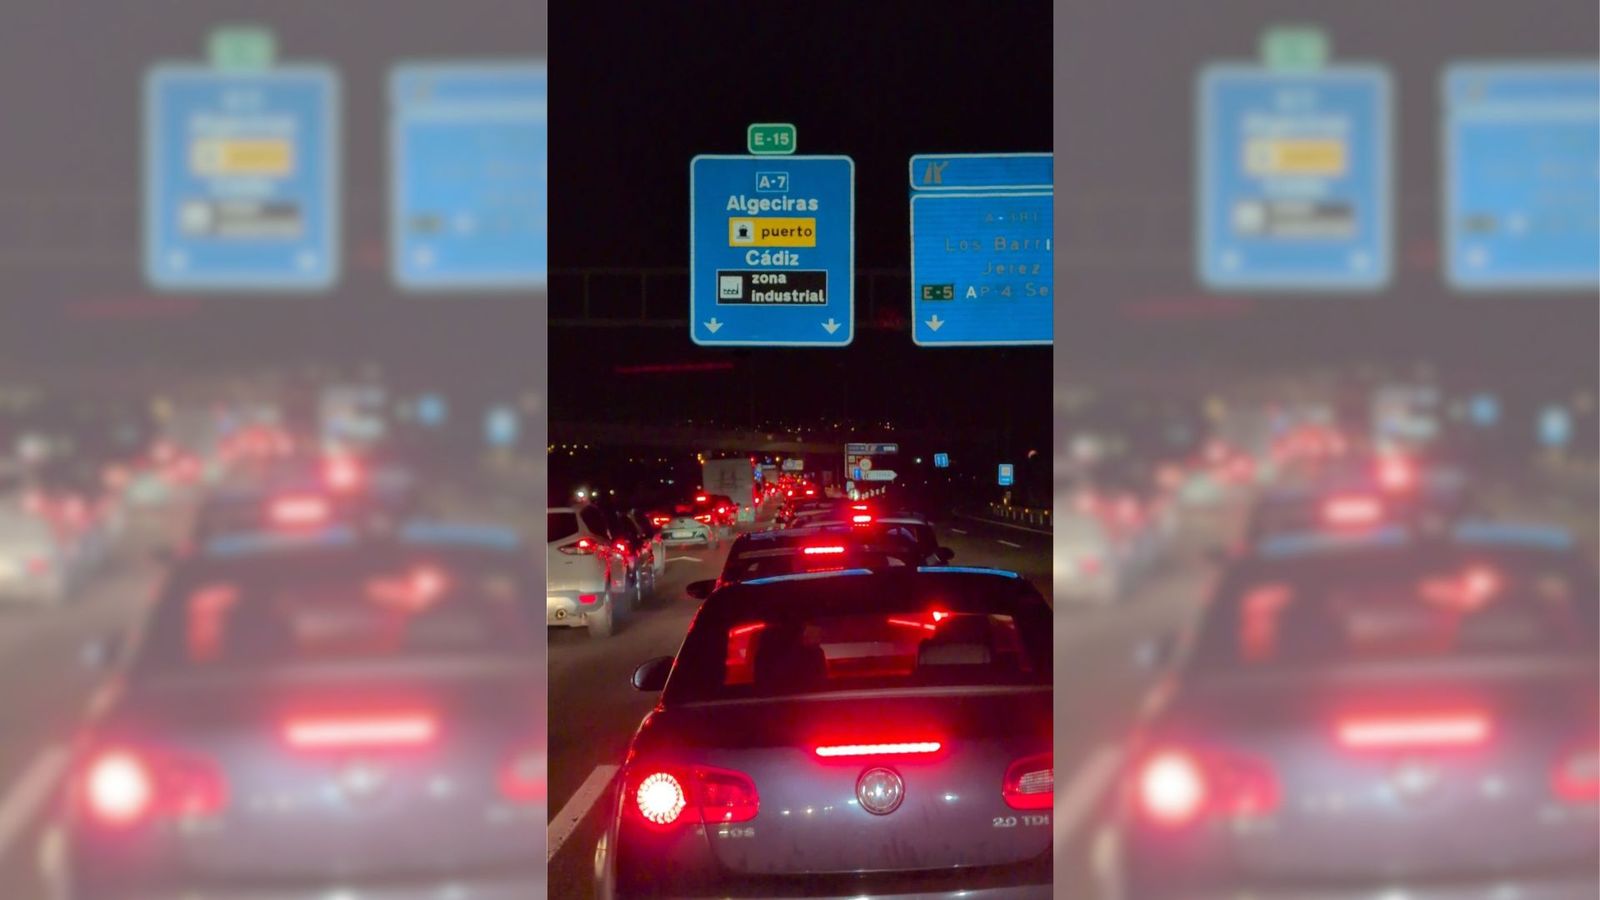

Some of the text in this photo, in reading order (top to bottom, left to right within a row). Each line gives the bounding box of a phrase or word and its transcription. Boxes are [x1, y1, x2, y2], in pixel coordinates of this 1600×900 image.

[754, 132, 789, 146] E-15
[758, 175, 787, 188] A-7
[726, 195, 819, 215] Algeciras
[761, 225, 813, 241] puerto
[945, 237, 982, 251] Los
[745, 249, 799, 266] Cádiz
[982, 261, 1041, 275] Jerez
[752, 273, 787, 284] zona
[751, 288, 825, 304] industrial
[923, 286, 953, 299] E-5
[1021, 814, 1050, 827] TDI
